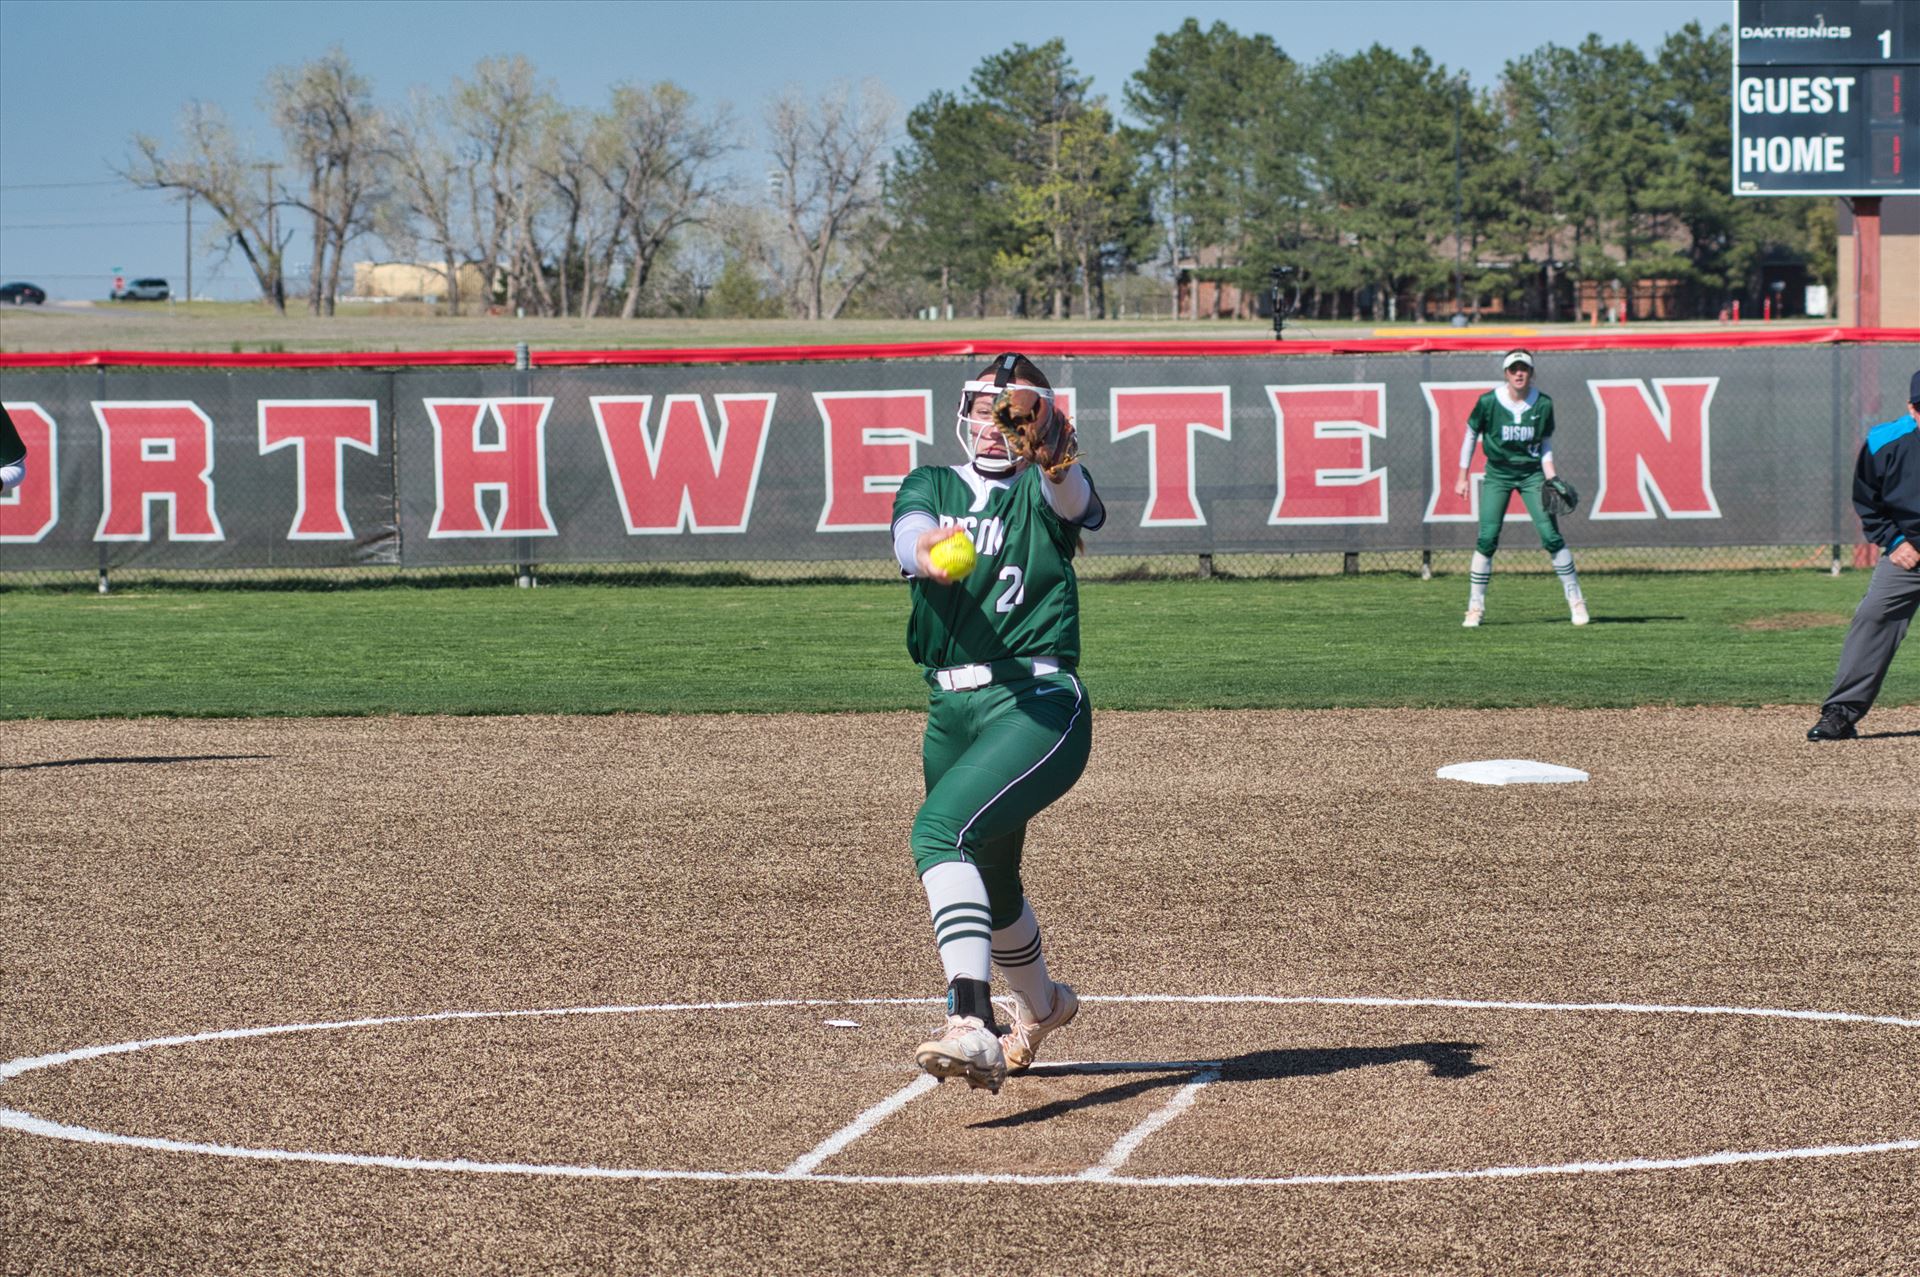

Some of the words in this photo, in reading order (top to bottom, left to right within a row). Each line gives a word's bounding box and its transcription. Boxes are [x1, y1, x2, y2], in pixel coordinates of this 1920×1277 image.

[1740, 27, 1852, 39] DAKTRONICS
[1877, 29, 1892, 59] 1
[1740, 77, 1856, 114] GUEST
[1742, 136, 1846, 173] HOME
[1502, 425, 1535, 441] BISON
